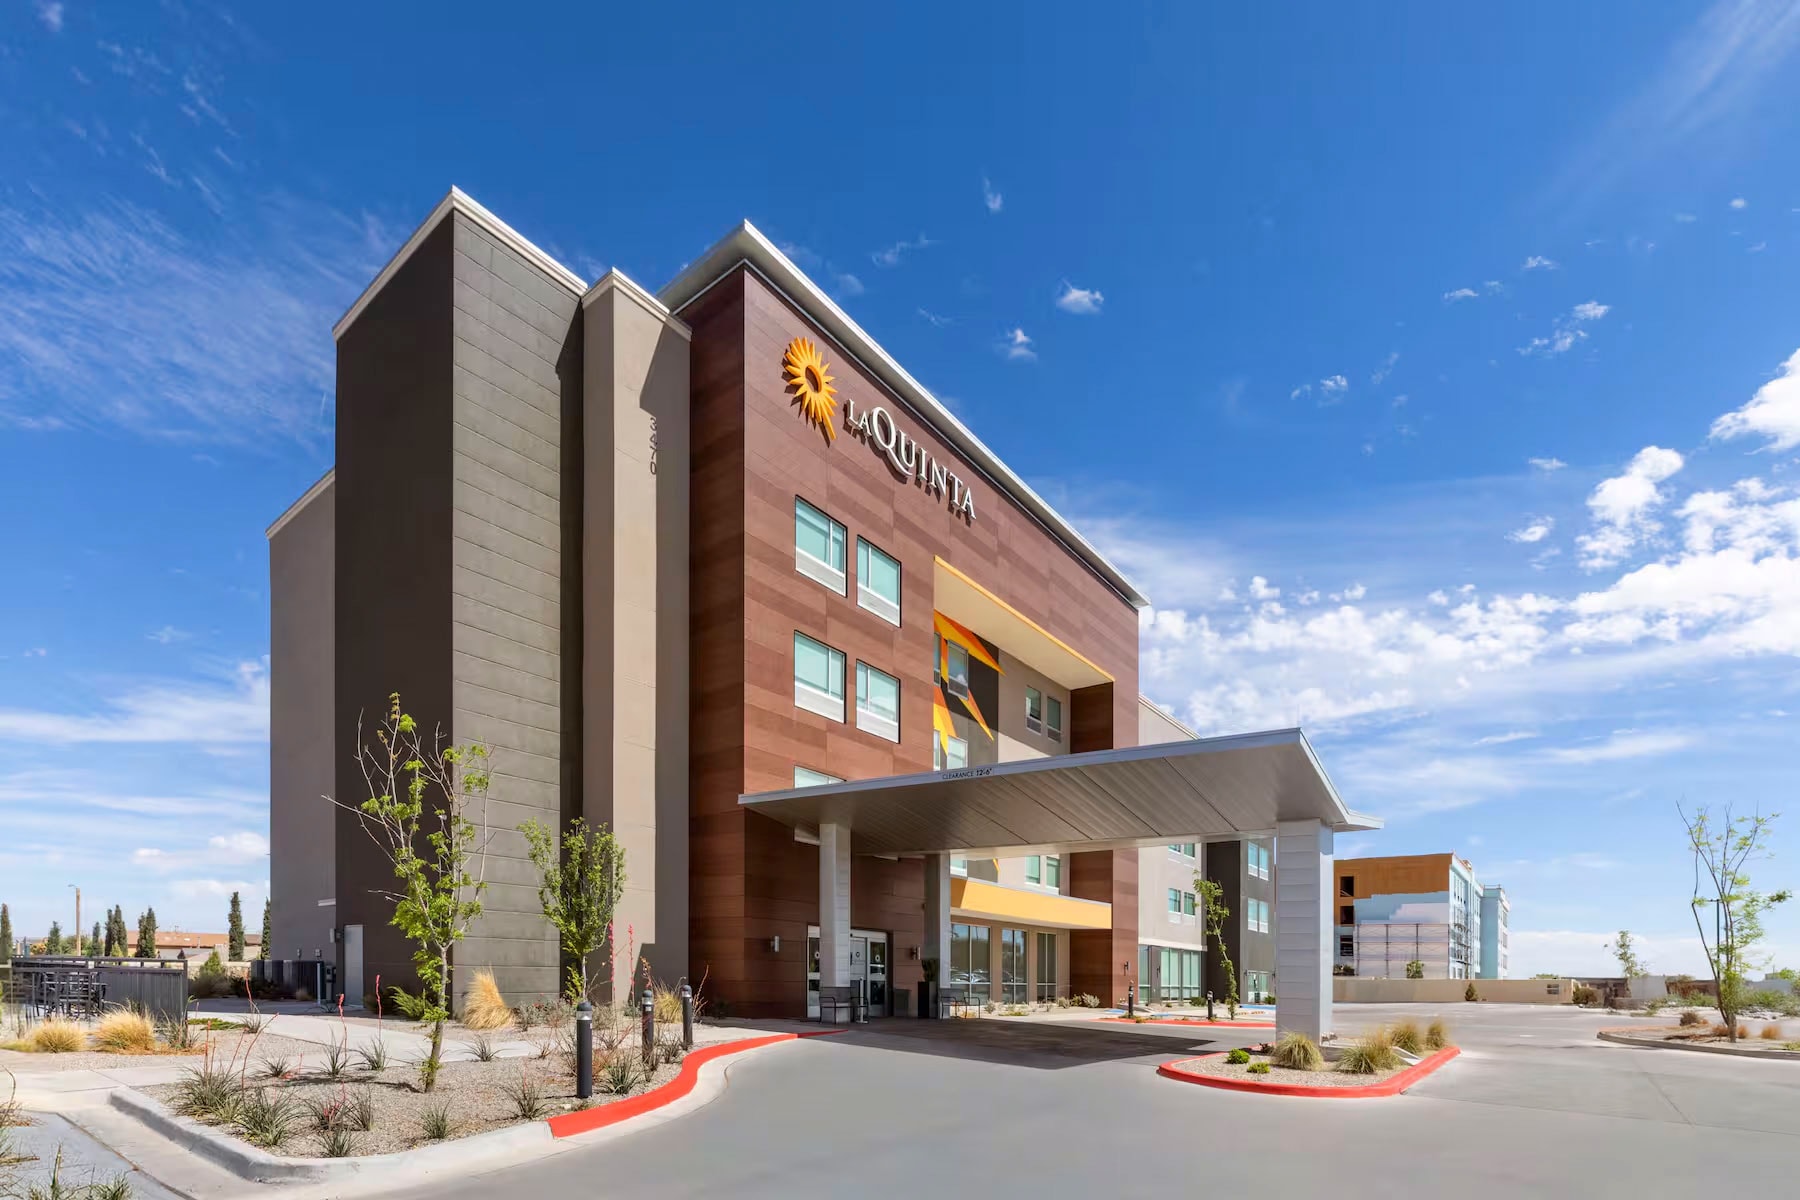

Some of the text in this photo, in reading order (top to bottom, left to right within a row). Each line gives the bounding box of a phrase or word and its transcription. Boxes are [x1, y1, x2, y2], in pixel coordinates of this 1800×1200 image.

[847, 398, 976, 519] LA QUINTA
[942, 771, 974, 779] CLEARANCE
